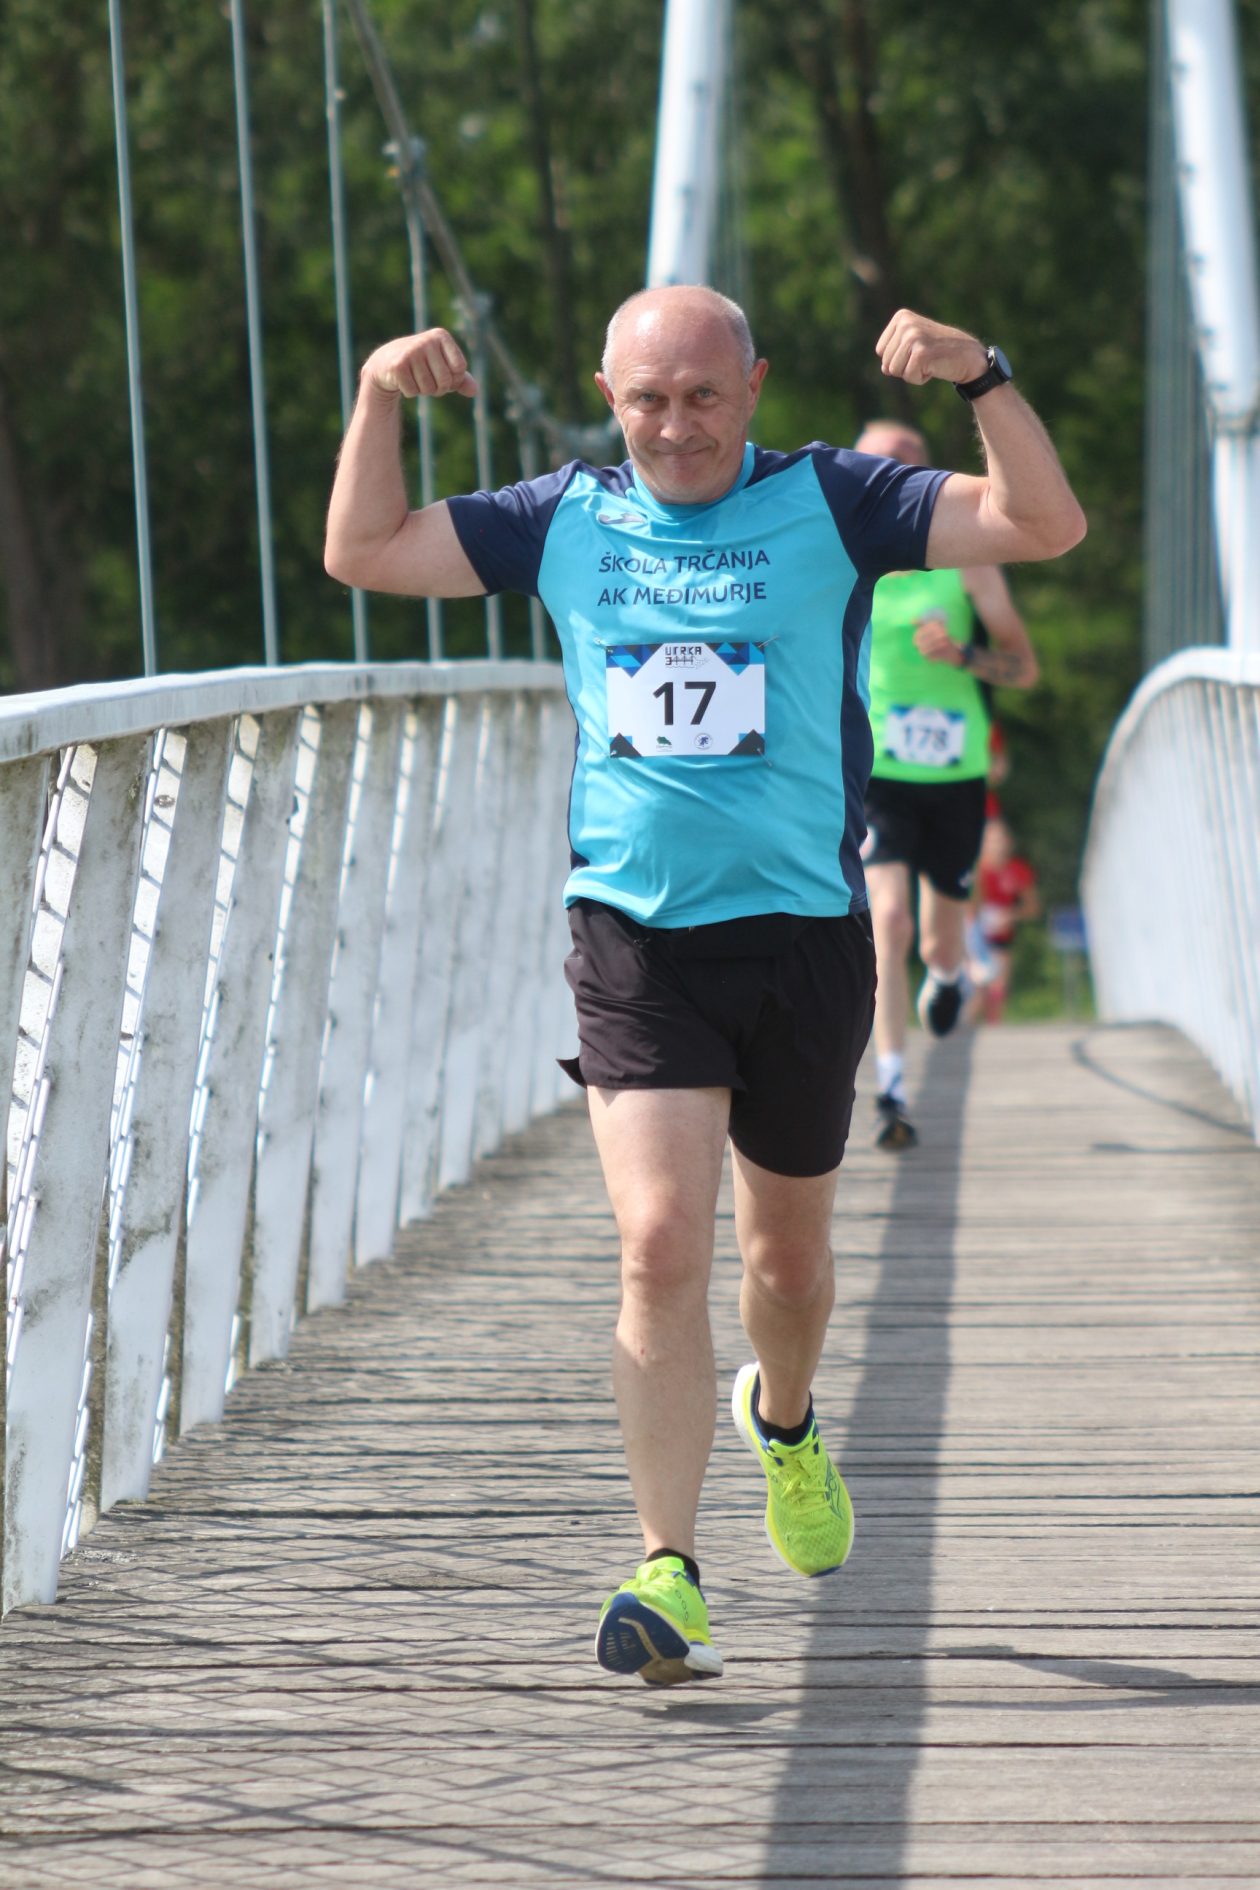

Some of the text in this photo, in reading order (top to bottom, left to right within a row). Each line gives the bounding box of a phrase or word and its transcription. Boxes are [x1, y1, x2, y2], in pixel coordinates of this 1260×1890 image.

[598, 549, 770, 574] ŠKOLA TRČANJA
[597, 582, 767, 606] AK MEĐIMURJE
[653, 681, 716, 726] 17
